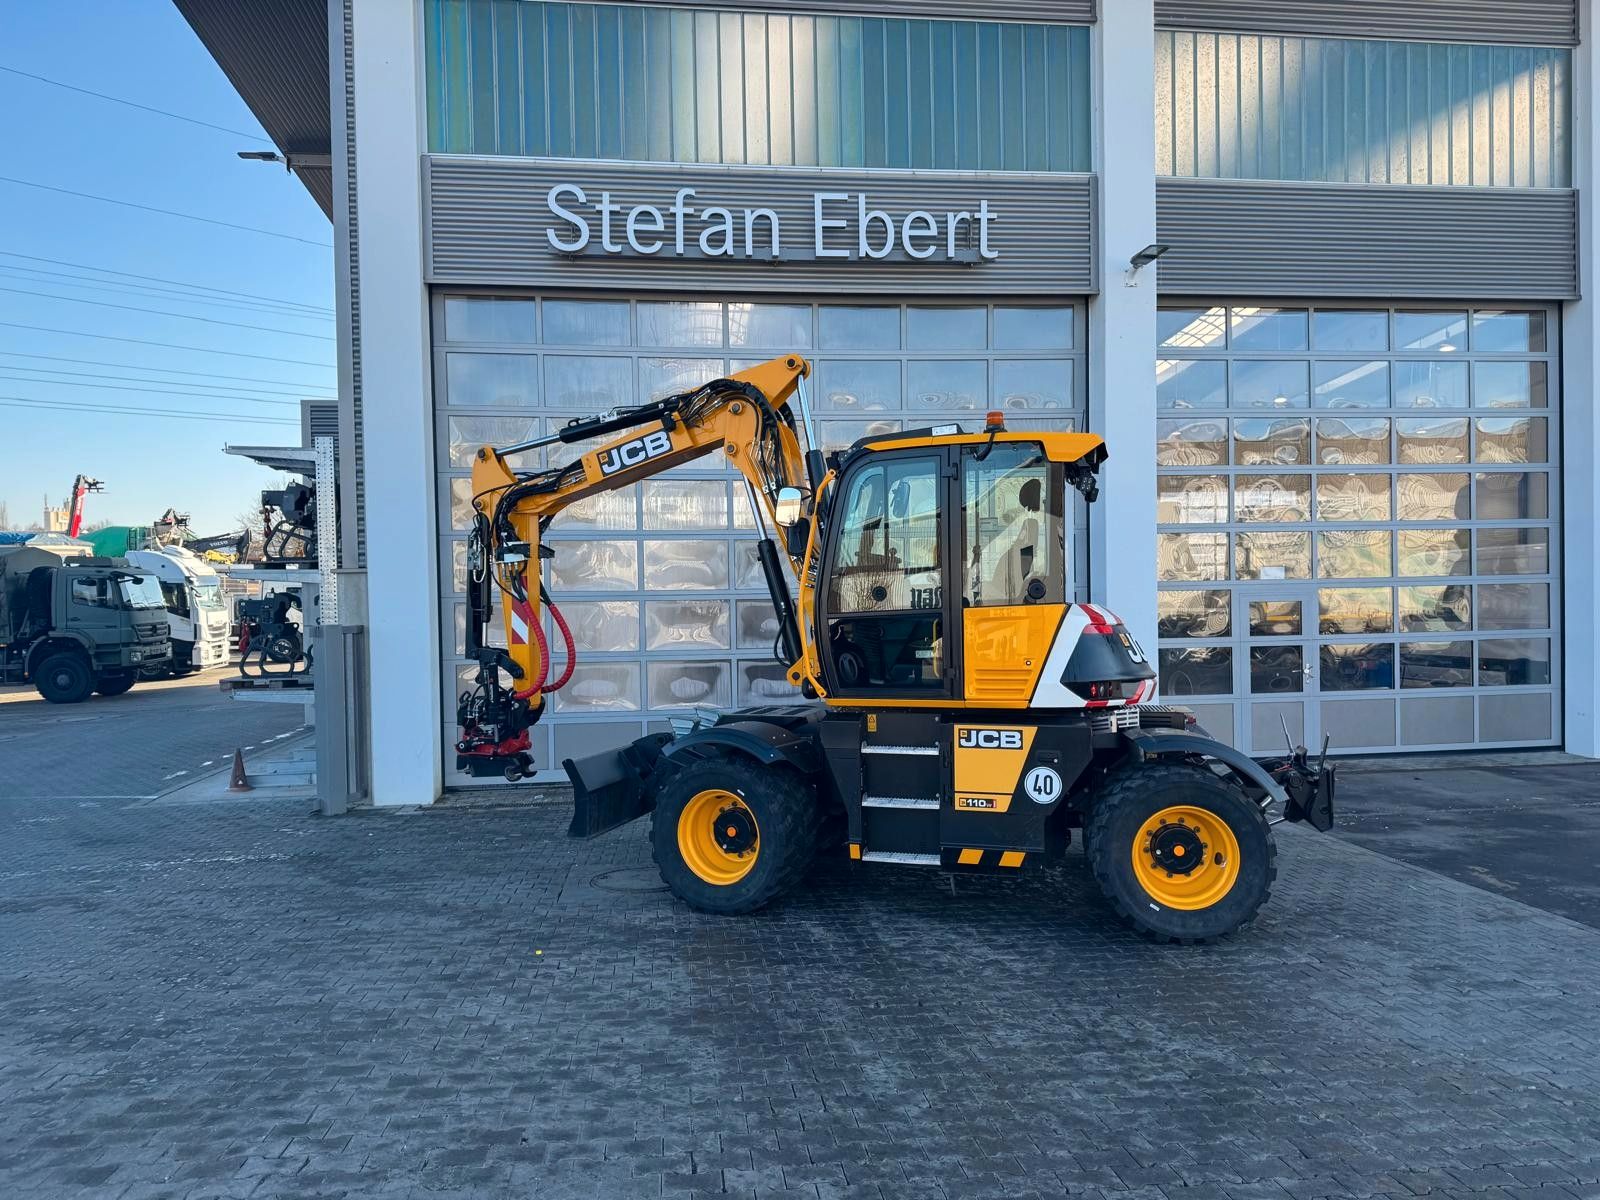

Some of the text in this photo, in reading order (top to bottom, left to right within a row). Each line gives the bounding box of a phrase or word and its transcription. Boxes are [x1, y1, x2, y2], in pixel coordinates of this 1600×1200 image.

[545, 183, 999, 260] Stefan Ebert
[601, 430, 671, 474] JCB
[960, 730, 1022, 748] JCB
[1033, 774, 1054, 796] 40
